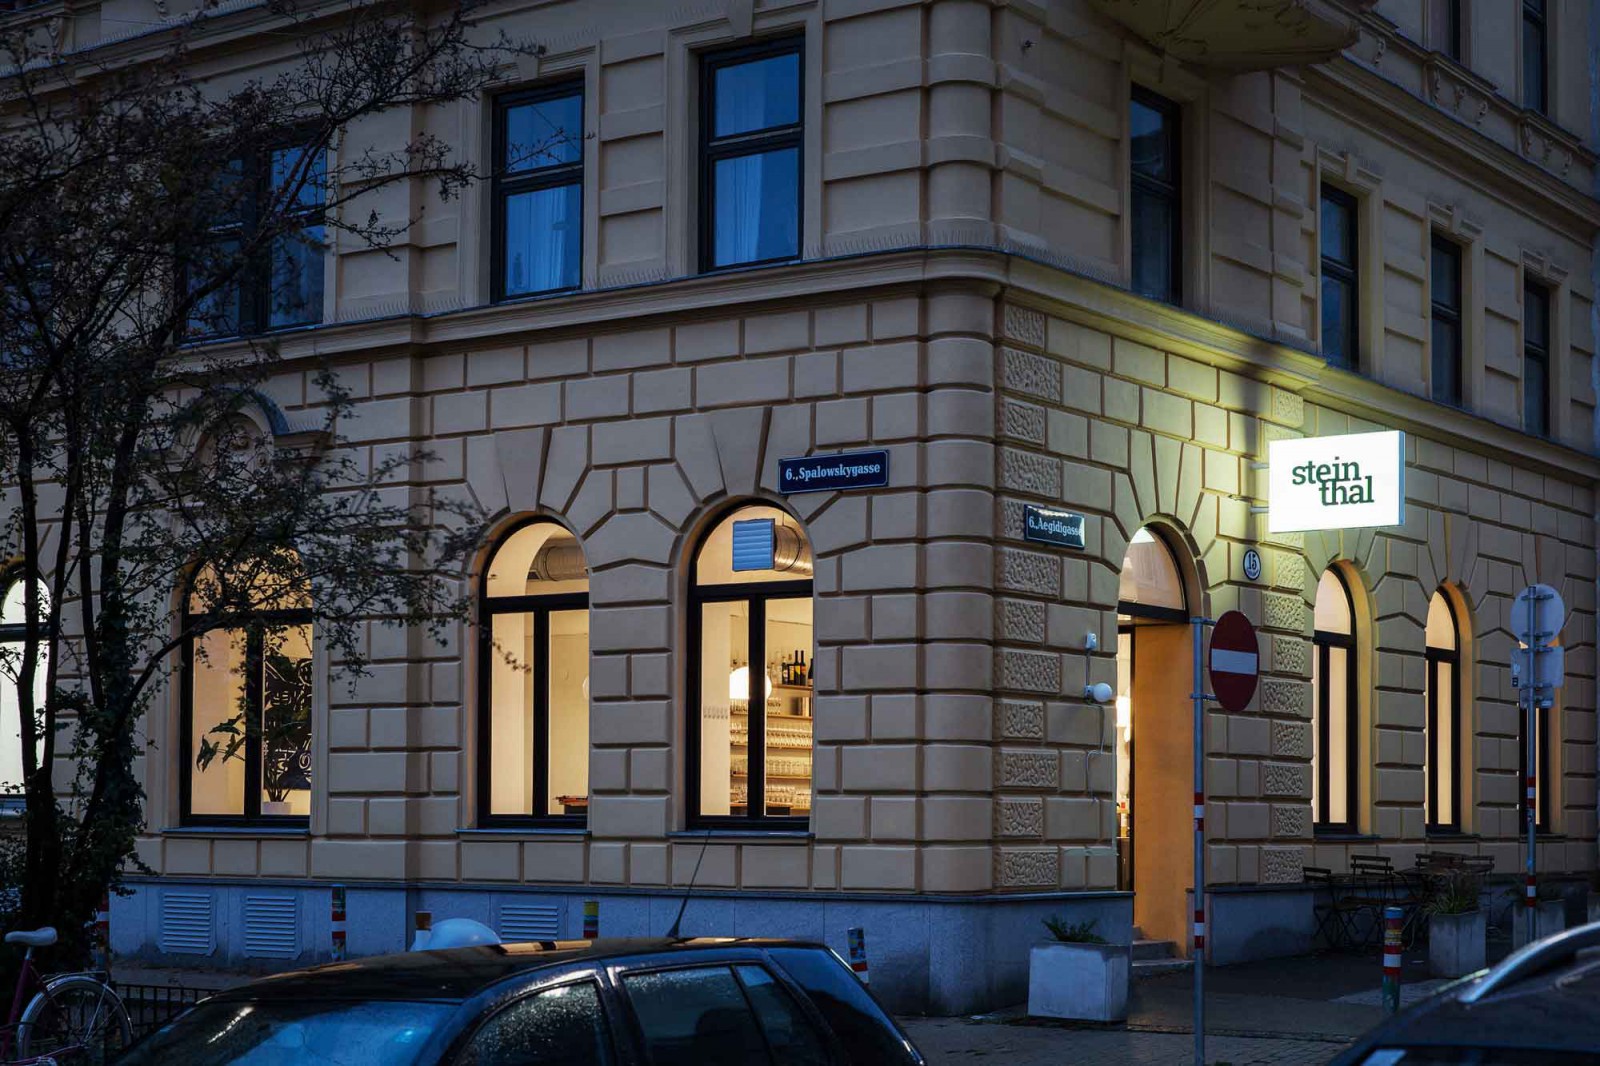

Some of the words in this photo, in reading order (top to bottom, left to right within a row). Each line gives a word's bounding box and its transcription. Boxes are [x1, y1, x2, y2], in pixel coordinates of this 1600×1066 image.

[1292, 456, 1362, 485] stein
[1319, 475, 1375, 506] thal
[1248, 553, 1258, 570] 15
